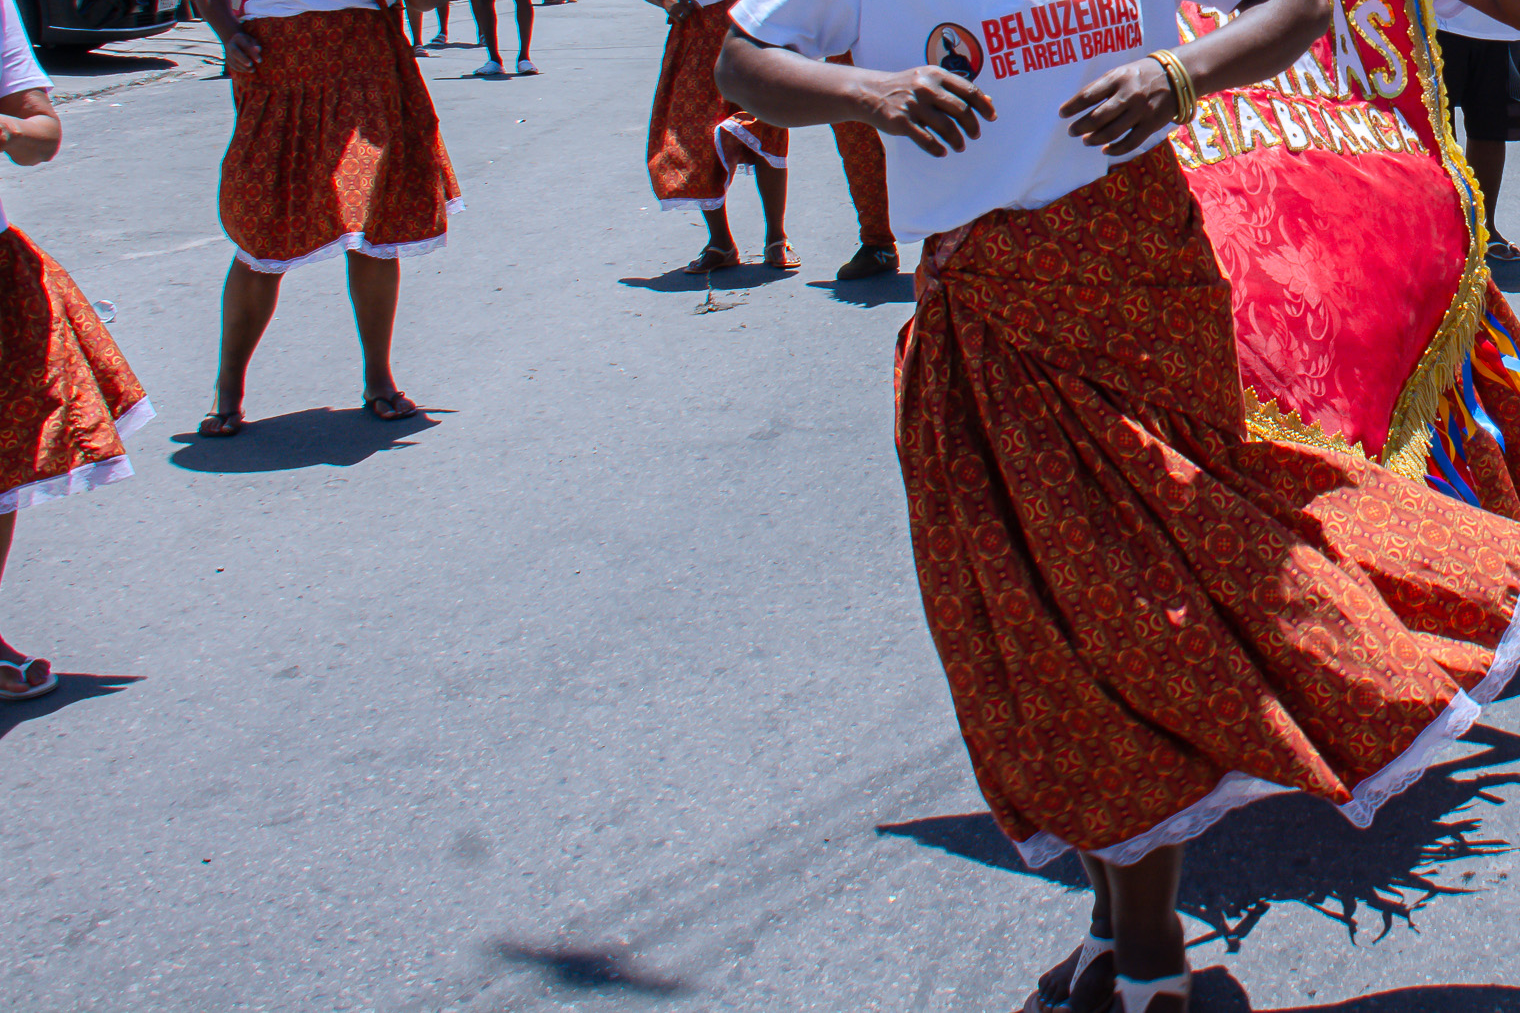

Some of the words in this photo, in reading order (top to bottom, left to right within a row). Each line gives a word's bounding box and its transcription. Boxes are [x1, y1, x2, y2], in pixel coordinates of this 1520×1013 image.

[990, 51, 1020, 80] DE
[1022, 37, 1078, 74] AREIA
[1079, 21, 1143, 60] BRANCA
[1267, 93, 1430, 156] BRANCA
